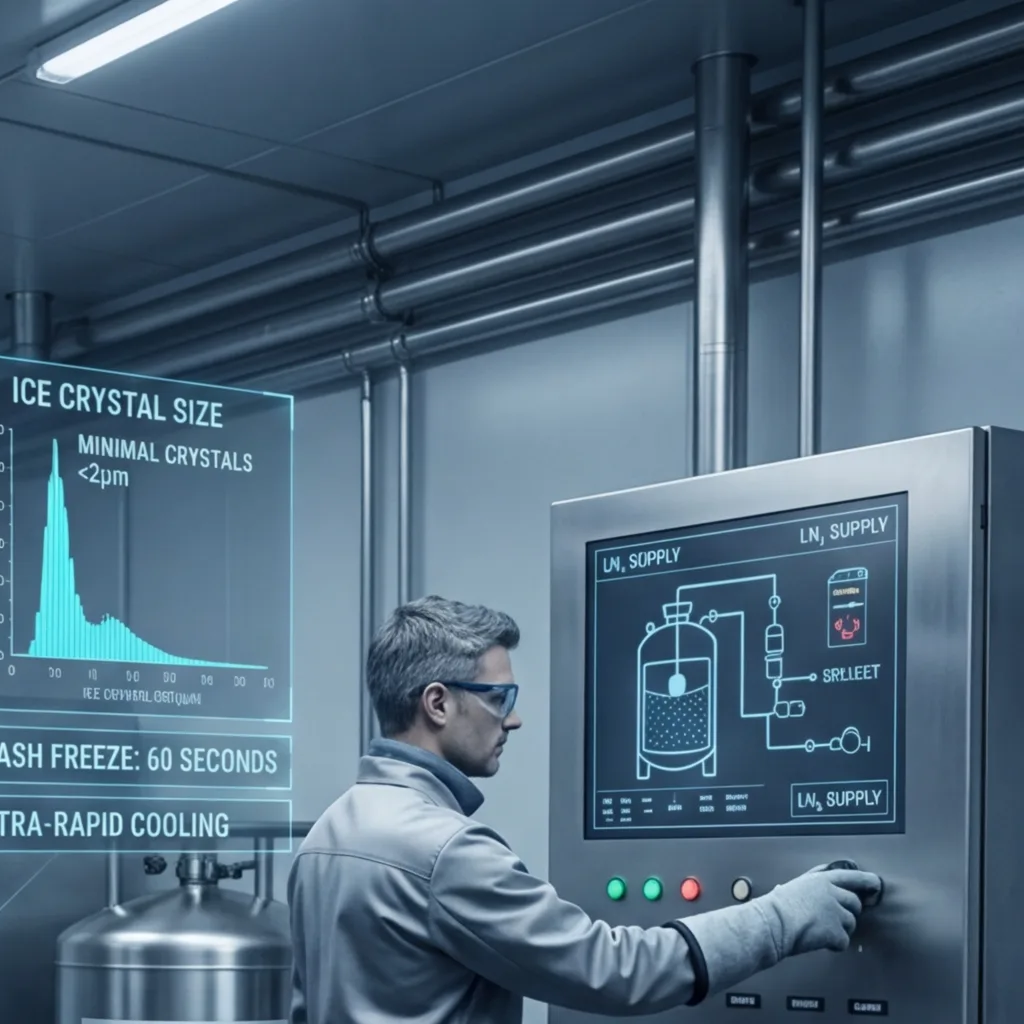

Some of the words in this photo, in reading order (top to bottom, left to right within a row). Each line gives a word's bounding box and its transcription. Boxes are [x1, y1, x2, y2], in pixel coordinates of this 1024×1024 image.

[12, 376, 52, 408] ICE
[59, 382, 167, 422] CRYSTAL
[173, 398, 224, 429] SIZE
[78, 434, 159, 463] MINIMAL
[165, 444, 253, 473] CRYSTALS
[829, 515, 889, 540] SUPPLY
[629, 546, 681, 569] SUPPLY
[51, 744, 140, 771] FREEZE:
[147, 747, 173, 772] 60
[180, 747, 278, 774] SECONDS
[826, 789, 882, 807] SUPPLY
[130, 812, 230, 838] COOLING
